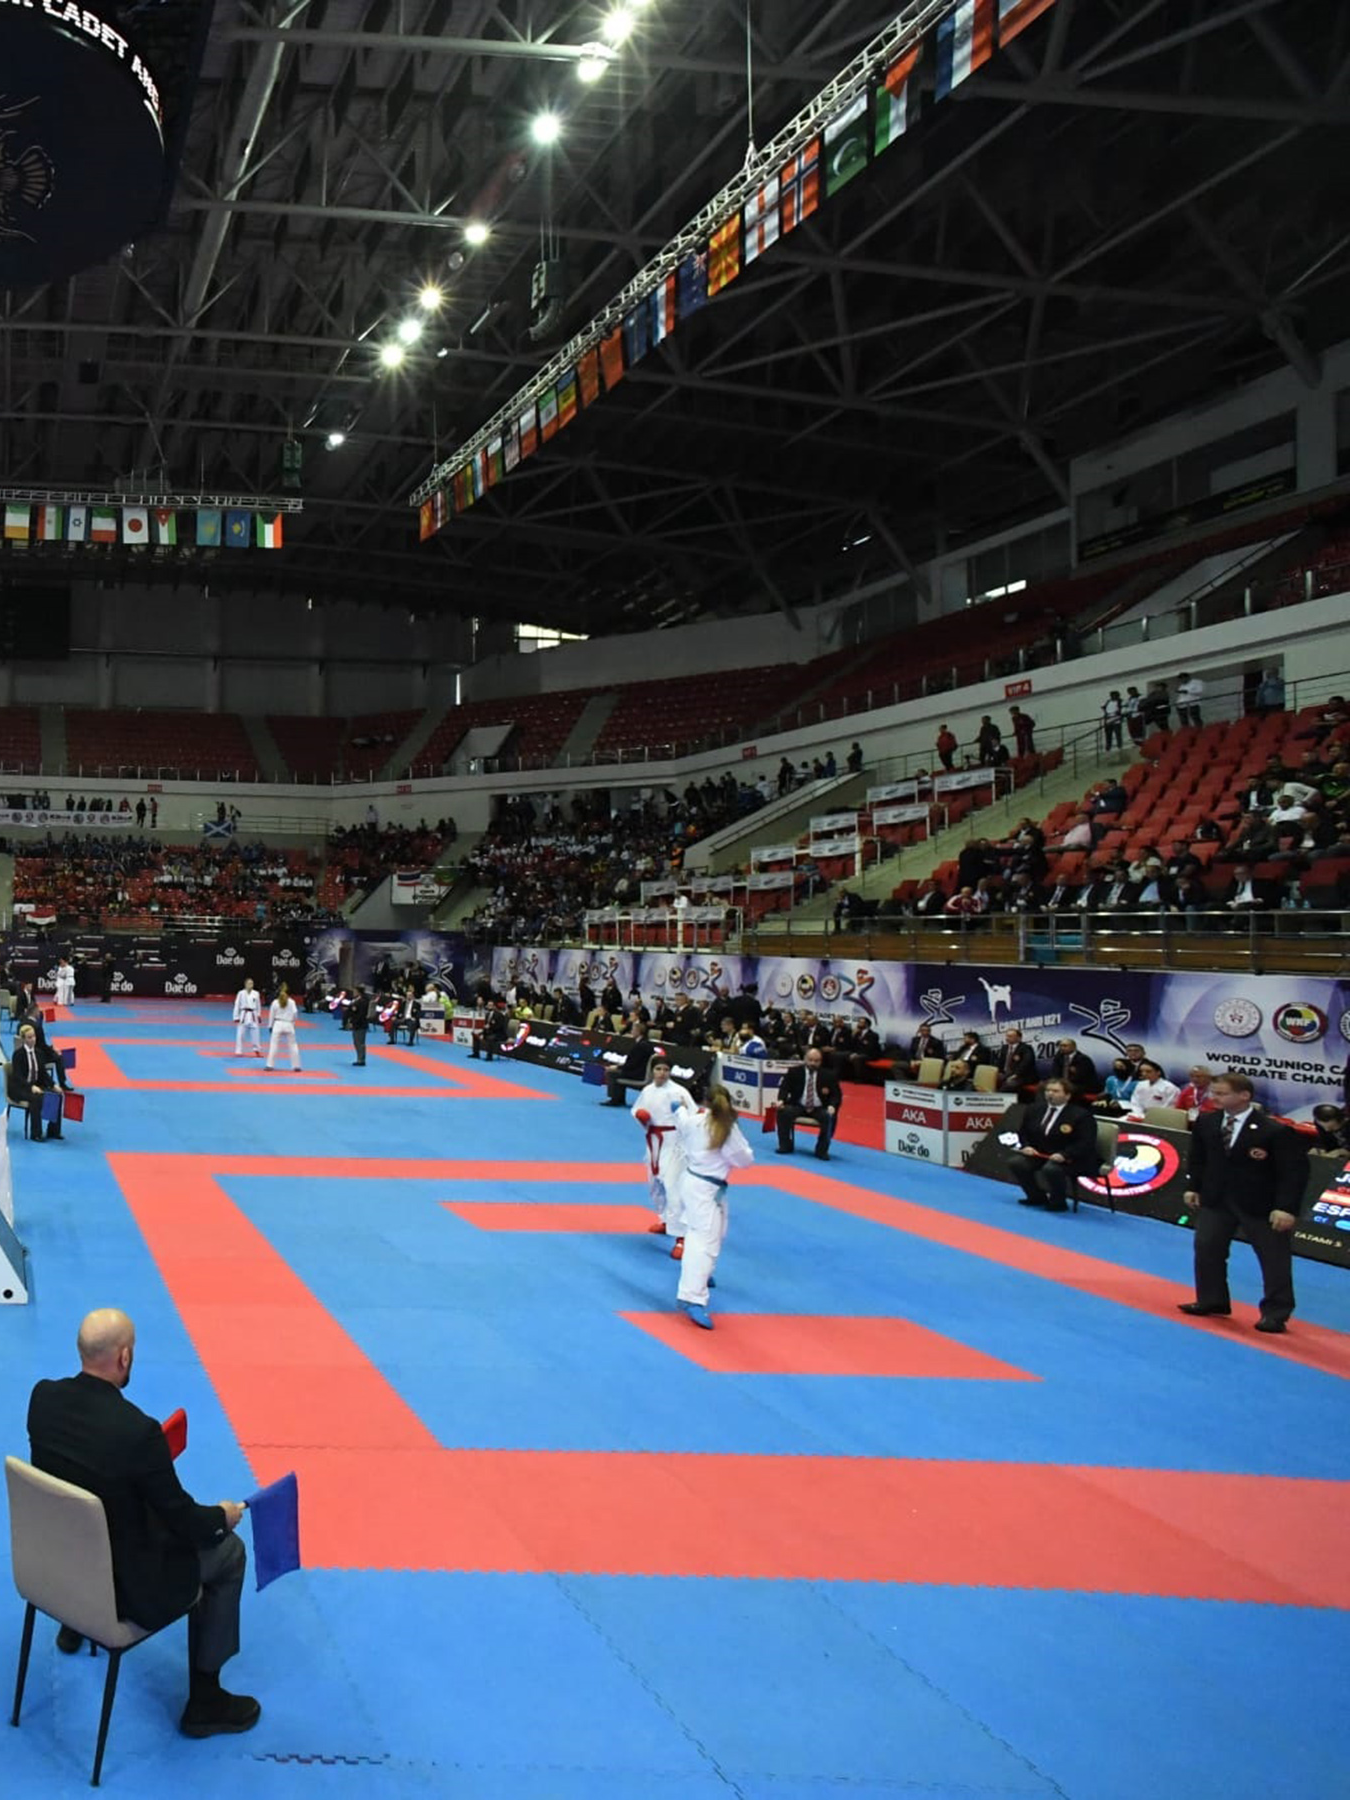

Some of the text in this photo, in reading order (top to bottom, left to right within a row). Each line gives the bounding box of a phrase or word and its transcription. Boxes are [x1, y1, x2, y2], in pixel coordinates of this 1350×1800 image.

[42, 0, 128, 58] CADET
[1206, 1052, 1261, 1066] WORLD
[1264, 1058, 1325, 1073] JUNIOR
[1227, 1065, 1287, 1081] KARATE
[902, 1108, 926, 1123] AKA
[965, 1117, 994, 1129] AKA
